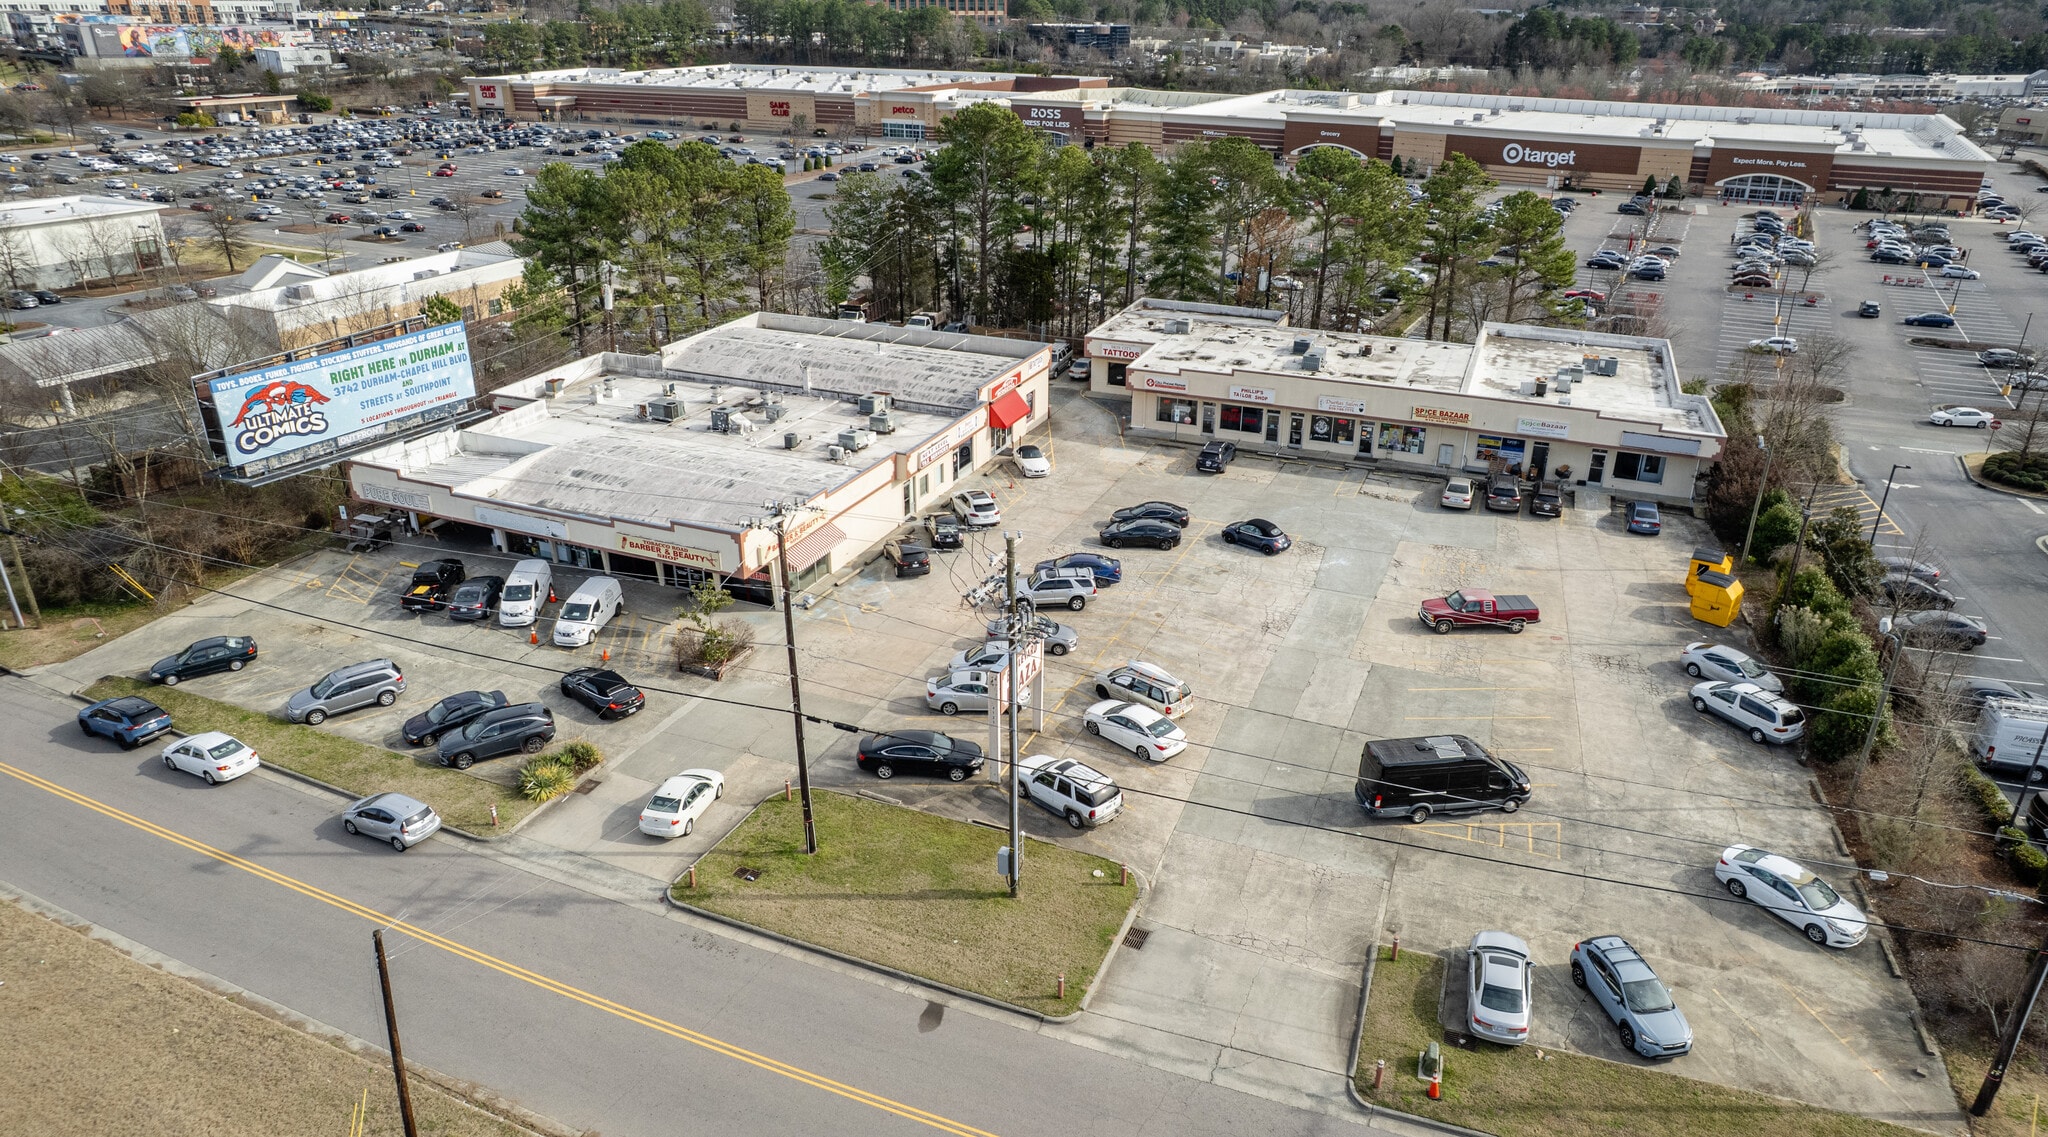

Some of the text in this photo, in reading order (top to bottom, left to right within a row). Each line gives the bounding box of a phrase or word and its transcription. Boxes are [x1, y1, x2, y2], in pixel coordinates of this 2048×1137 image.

[769, 101, 790, 109] SAM'S
[892, 105, 915, 114] petco
[771, 108, 789, 117] CLUB
[1031, 108, 1061, 119] ROSS
[1320, 130, 1341, 138] Grocery
[1524, 147, 1576, 167] target
[1733, 157, 1807, 168] Expect More. Pay Less.
[216, 380, 238, 391] TOYS.
[239, 374, 264, 385] BOOKS.
[265, 367, 290, 379] FUNKO.
[290, 361, 320, 374] FIGURES.
[320, 352, 352, 367] STOCKING
[383, 336, 417, 352] THOUSANDS
[418, 333, 426, 342] OF
[426, 329, 444, 340] GREAT
[1103, 349, 1140, 359] TATTOOS
[330, 341, 465, 385] RIGHT HERE IN DURHAM AT
[333, 353, 468, 397] 3742 DURHAM-CHAPEL HILL BLVD
[402, 379, 413, 387] AND
[360, 393, 394, 410] STREETS
[404, 377, 451, 397] SOUTHPOINT
[1233, 391, 1251, 399] TAILOR
[366, 409, 394, 423] LOCATIONS
[394, 400, 427, 414] THROUGHOUT
[435, 391, 457, 402] TRIANGLE
[1415, 407, 1437, 416] SPICE
[1440, 410, 1469, 420] BAZAAR
[244, 404, 312, 430] ULTIMATE
[240, 413, 326, 450] COMICS
[340, 424, 385, 444] OUTFRONT
[365, 487, 390, 502] PURE
[391, 491, 419, 508] SOUL
[643, 540, 670, 549] TOBACCO
[629, 541, 661, 554] BARBER
[673, 550, 704, 562] BEAUTY
[657, 553, 678, 561] SHOP
